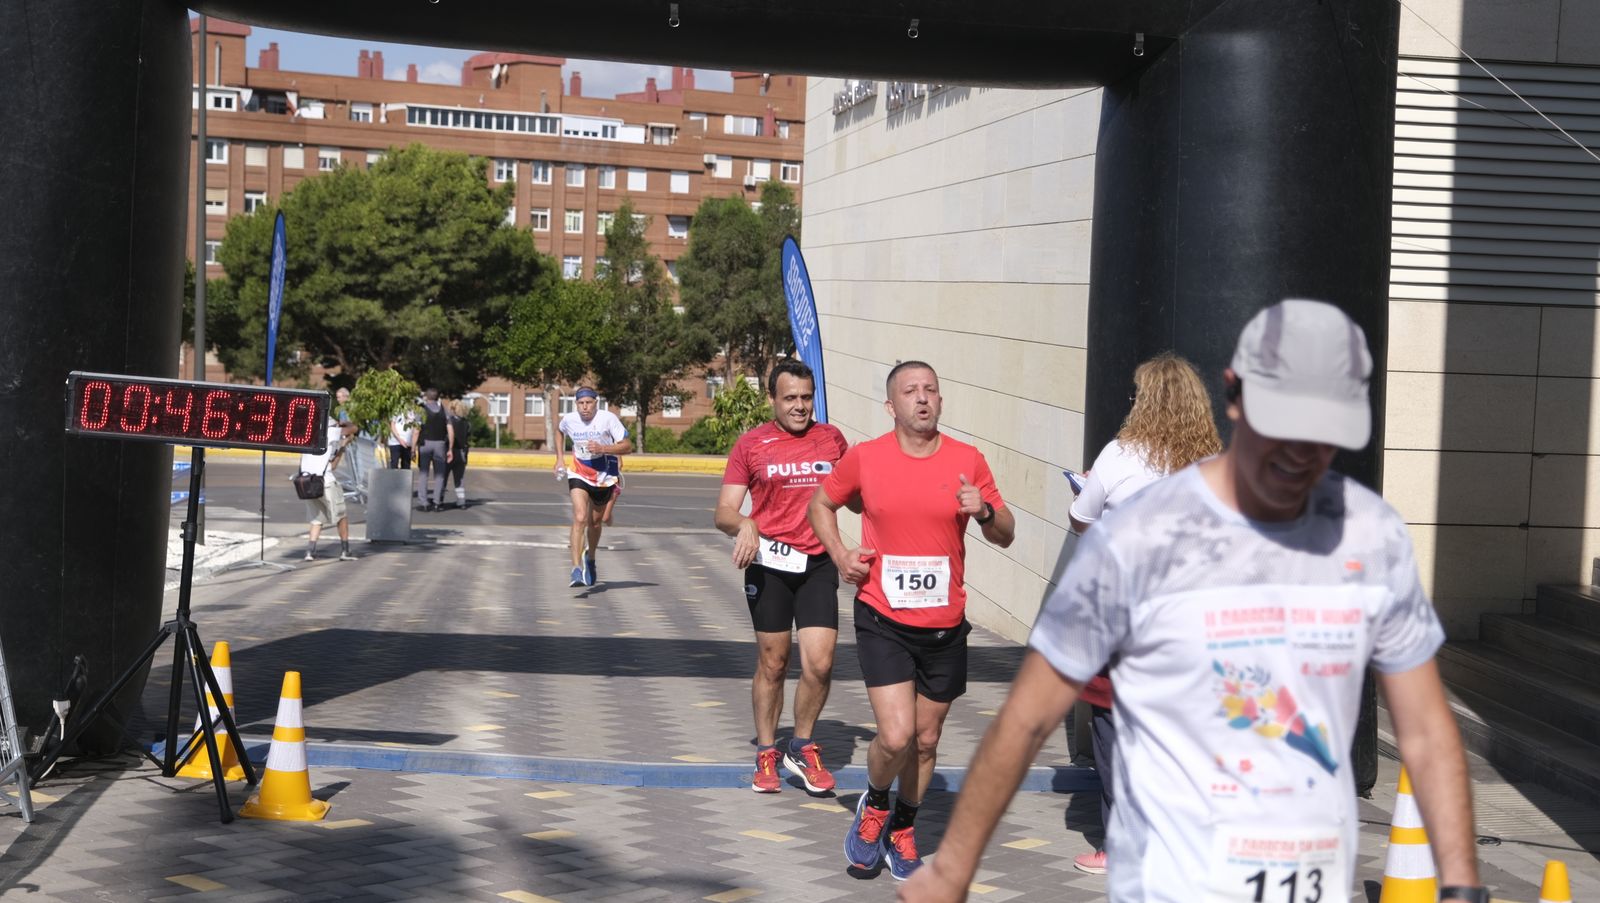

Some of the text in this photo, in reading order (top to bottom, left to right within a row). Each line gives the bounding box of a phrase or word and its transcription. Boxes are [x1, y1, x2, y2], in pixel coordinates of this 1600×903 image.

[80, 381, 316, 445] 00:46:30
[767, 461, 832, 478] PULSO
[769, 541, 791, 556] 40
[895, 574, 937, 590] 150
[1246, 868, 1323, 903] 113
